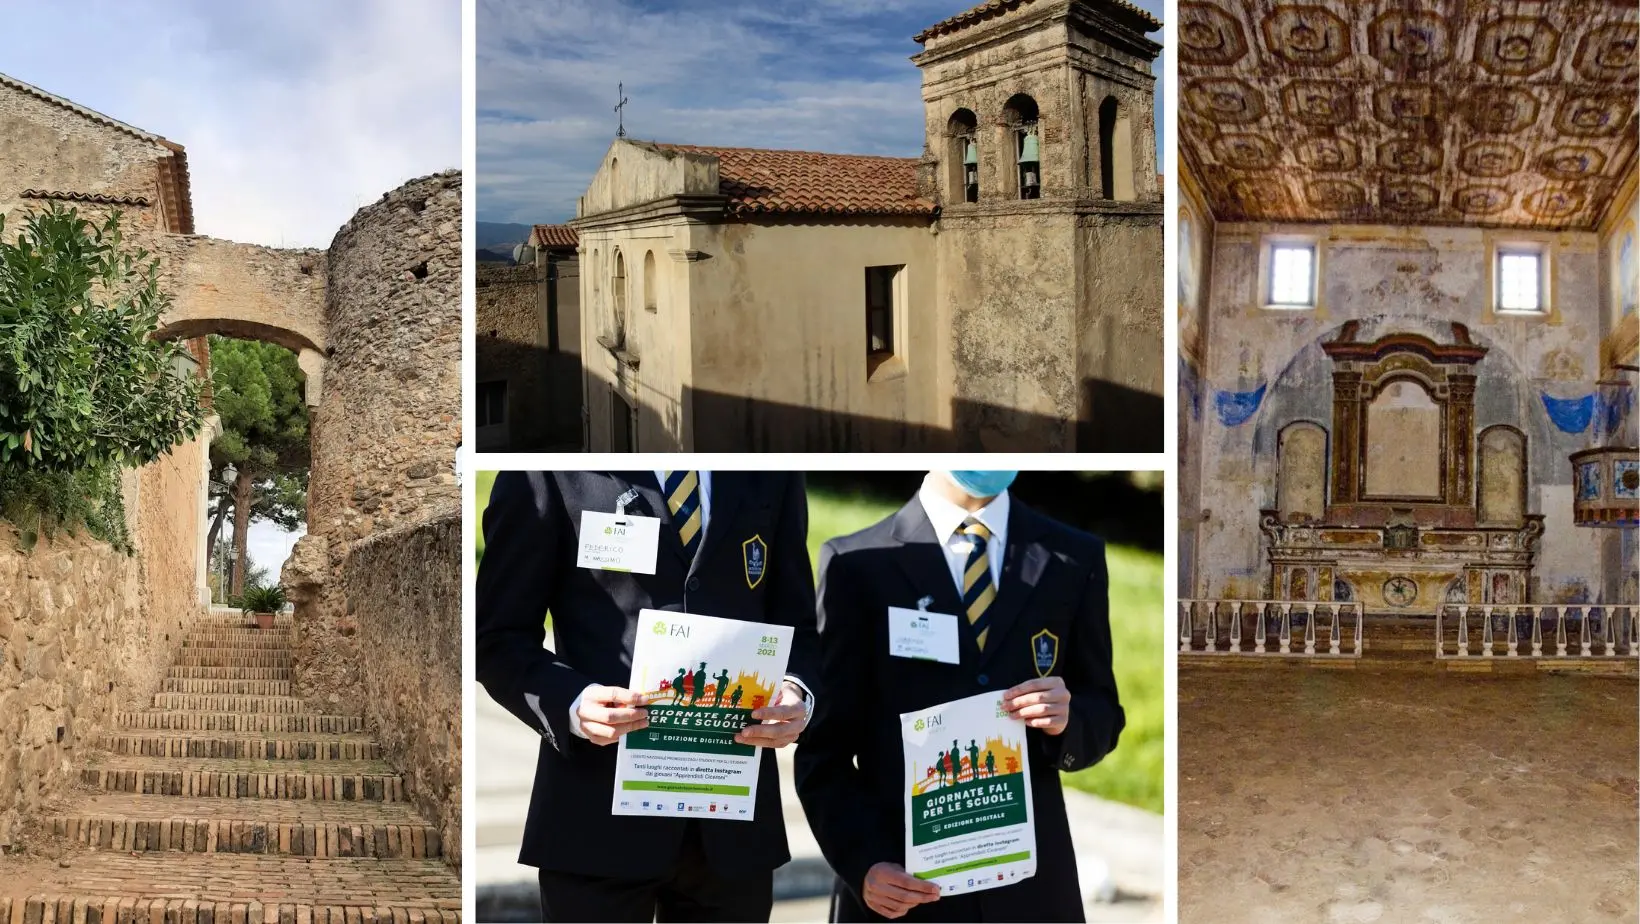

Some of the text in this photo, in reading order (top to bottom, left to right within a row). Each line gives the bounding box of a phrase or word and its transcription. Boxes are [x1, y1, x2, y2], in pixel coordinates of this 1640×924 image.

[584, 543, 624, 553] FEDERICO
[670, 623, 691, 639] FAI
[756, 648, 777, 657] 2021
[650, 709, 746, 721] GIORNATE FAI
[927, 714, 942, 728] FAI
[673, 717, 689, 726] LE
[694, 718, 748, 729] SCUOLE
[663, 735, 698, 743] EDIZIONE
[646, 764, 662, 772] luoghi
[926, 783, 1008, 808] GIORNATE FAI
[923, 792, 1013, 819] PER LE SCUOLE
[943, 813, 1005, 830] EDIZIONE DIGITALE
